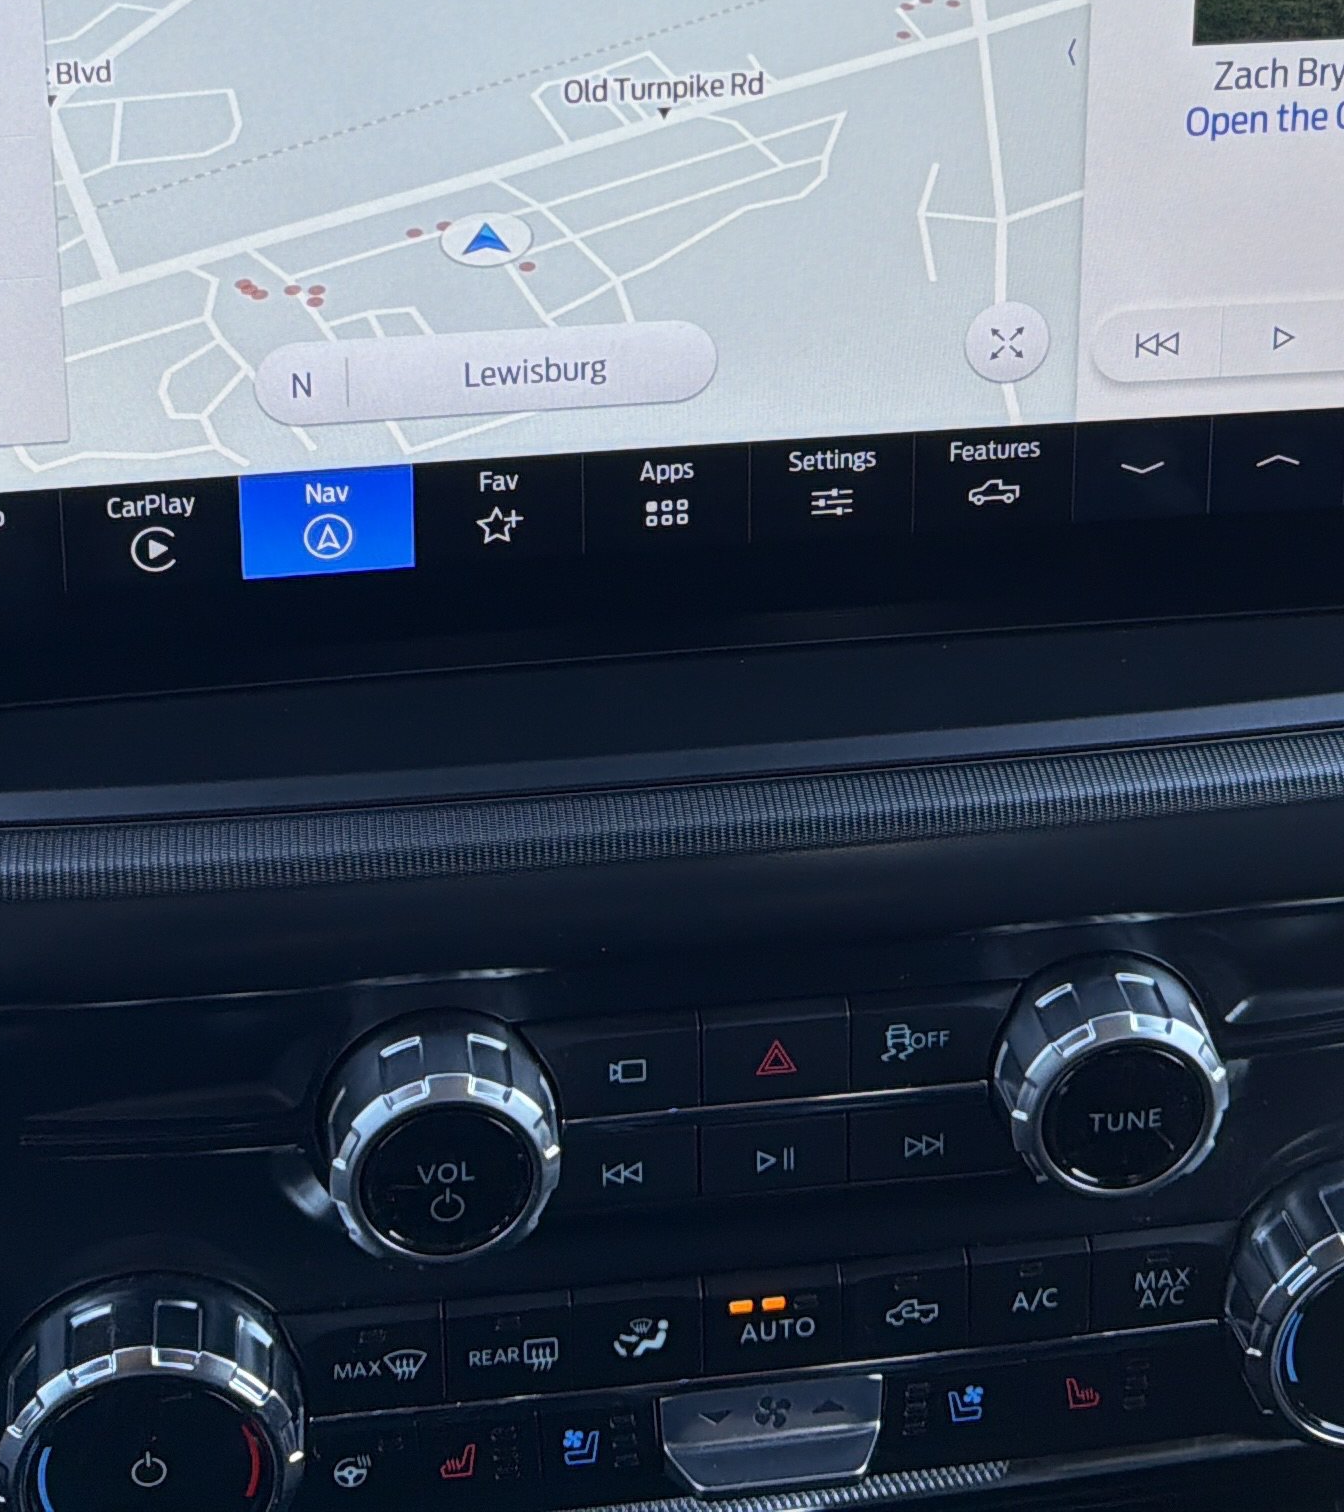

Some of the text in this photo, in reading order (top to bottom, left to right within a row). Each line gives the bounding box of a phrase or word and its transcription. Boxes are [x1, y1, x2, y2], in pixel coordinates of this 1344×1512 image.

[56, 59, 112, 85] Blvd
[1213, 57, 1289, 91] Zach
[564, 71, 764, 107] Old Turnpike Rd
[1186, 106, 1268, 142] Open
[1276, 101, 1328, 133] the
[464, 356, 607, 388] Lewisburg
[291, 372, 313, 399] N
[788, 449, 877, 473] Settings
[949, 439, 1041, 463] Features
[479, 471, 519, 492] Fav
[639, 460, 695, 485] Apps
[106, 493, 196, 520] CarPlay
[305, 483, 350, 505] Nav
[911, 1028, 951, 1051] OFF
[1089, 1107, 1163, 1133] TUNE
[417, 1161, 476, 1184] VOL
[1133, 1267, 1191, 1291] MAX
[1012, 1287, 1059, 1312] A/C
[1138, 1287, 1186, 1309] A/C
[739, 1316, 817, 1342] AUTO
[468, 1346, 520, 1367] REAR
[333, 1360, 382, 1381] MAX
